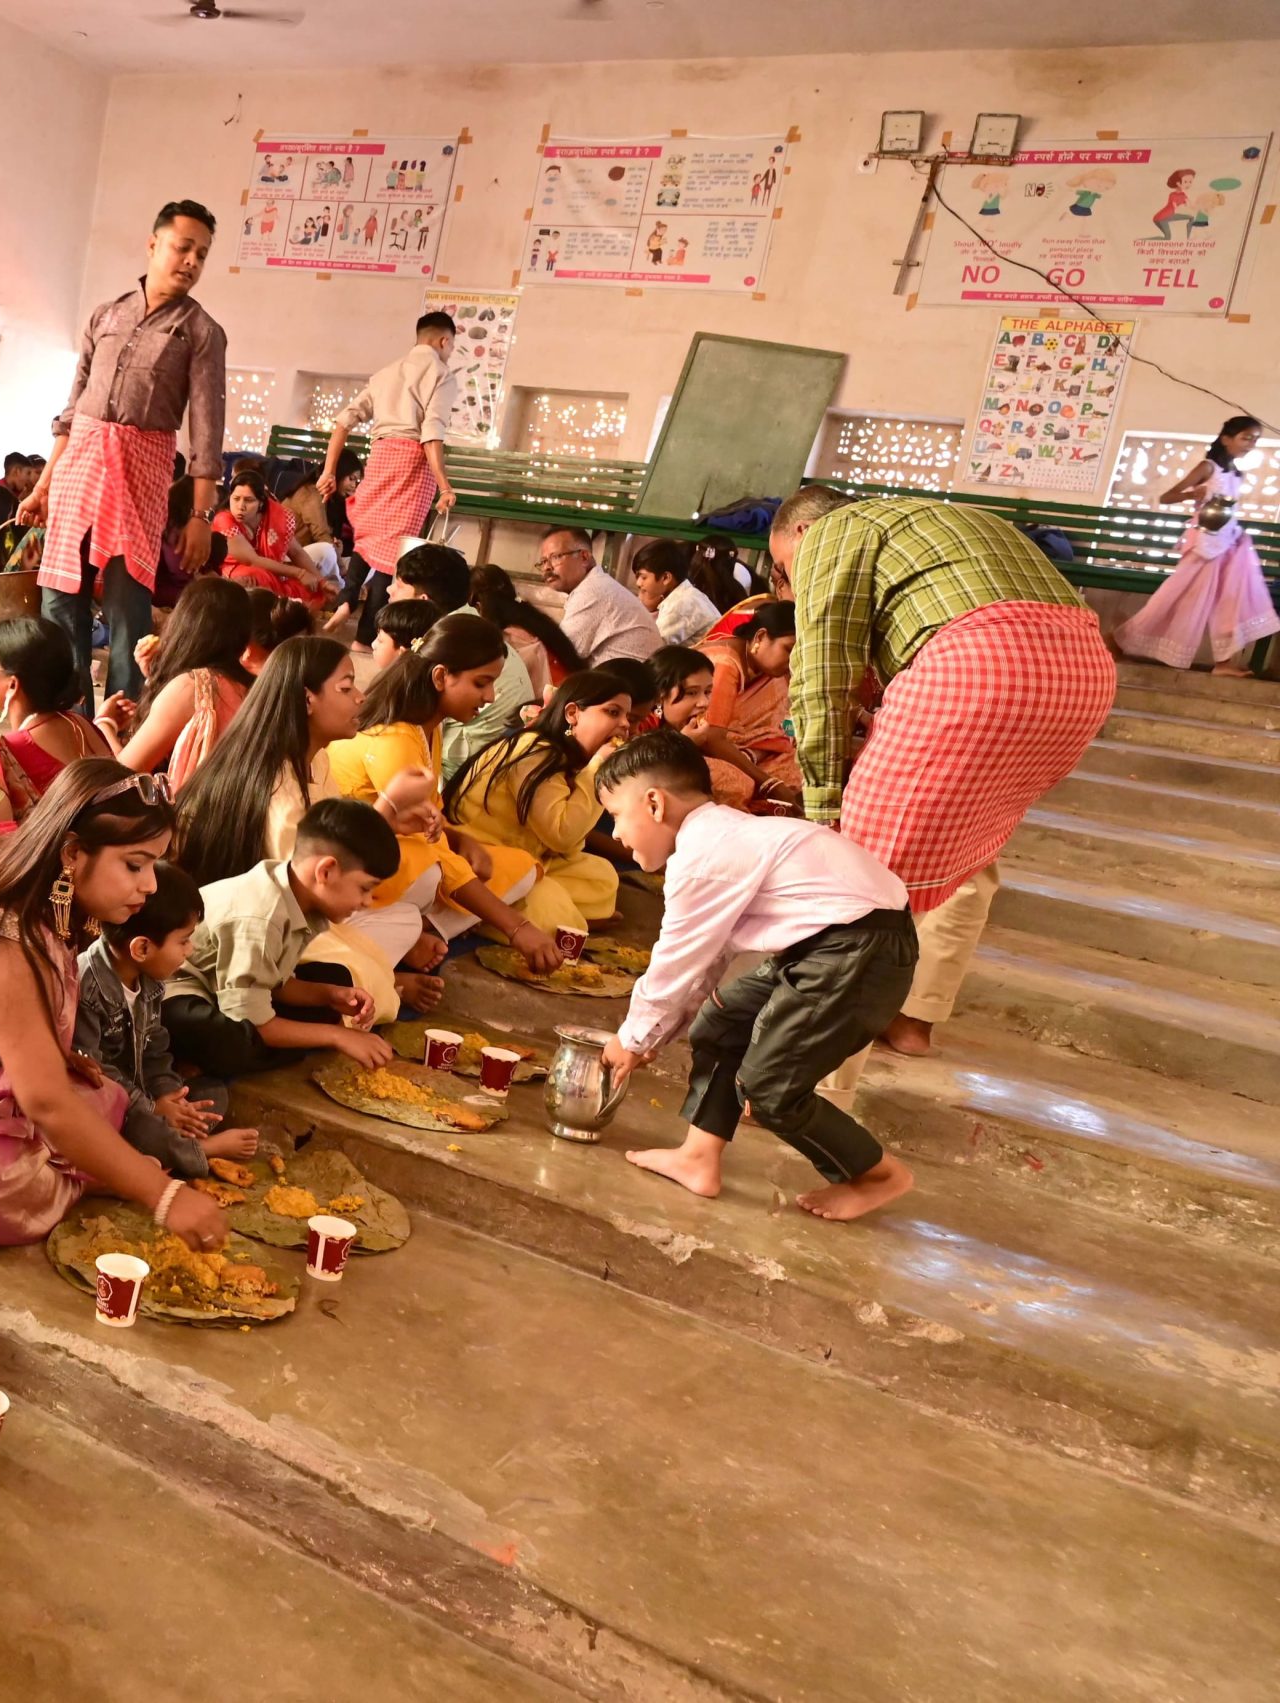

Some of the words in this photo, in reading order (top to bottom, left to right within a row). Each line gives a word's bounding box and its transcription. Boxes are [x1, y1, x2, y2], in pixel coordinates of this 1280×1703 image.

[1080, 153, 1090, 161] पर
[1095, 152, 1112, 161] क्या
[1000, 241, 1023, 249] loudly
[1186, 241, 1216, 249] trusted
[961, 265, 1001, 284] NO
[1046, 268, 1085, 287] GO
[1143, 269, 1199, 288] TELL
[1011, 319, 1040, 330] THE
[1045, 320, 1124, 333] ALPHABET
[999, 332, 1011, 345] A
[1032, 333, 1044, 346] B
[1064, 335, 1077, 348] C
[1097, 336, 1111, 349] D
[994, 354, 1008, 367] E
[1026, 355, 1038, 368] F
[1059, 357, 1073, 370] G
[1092, 359, 1106, 371] H
[1053, 379, 1068, 392] K
[1086, 381, 1097, 393] L
[984, 397, 1000, 410] M
[1016, 400, 1030, 412] N
[1048, 401, 1062, 414] O
[1081, 403, 1094, 415] P
[980, 419, 993, 433] Q
[1011, 421, 1024, 434] R
[1043, 423, 1055, 436] S
[1078, 425, 1090, 438] T
[975, 441, 987, 453] U
[1038, 445, 1055, 458] W
[1069, 448, 1083, 460] X
[971, 462, 982, 474] Y
[1000, 465, 1013, 477] Z
